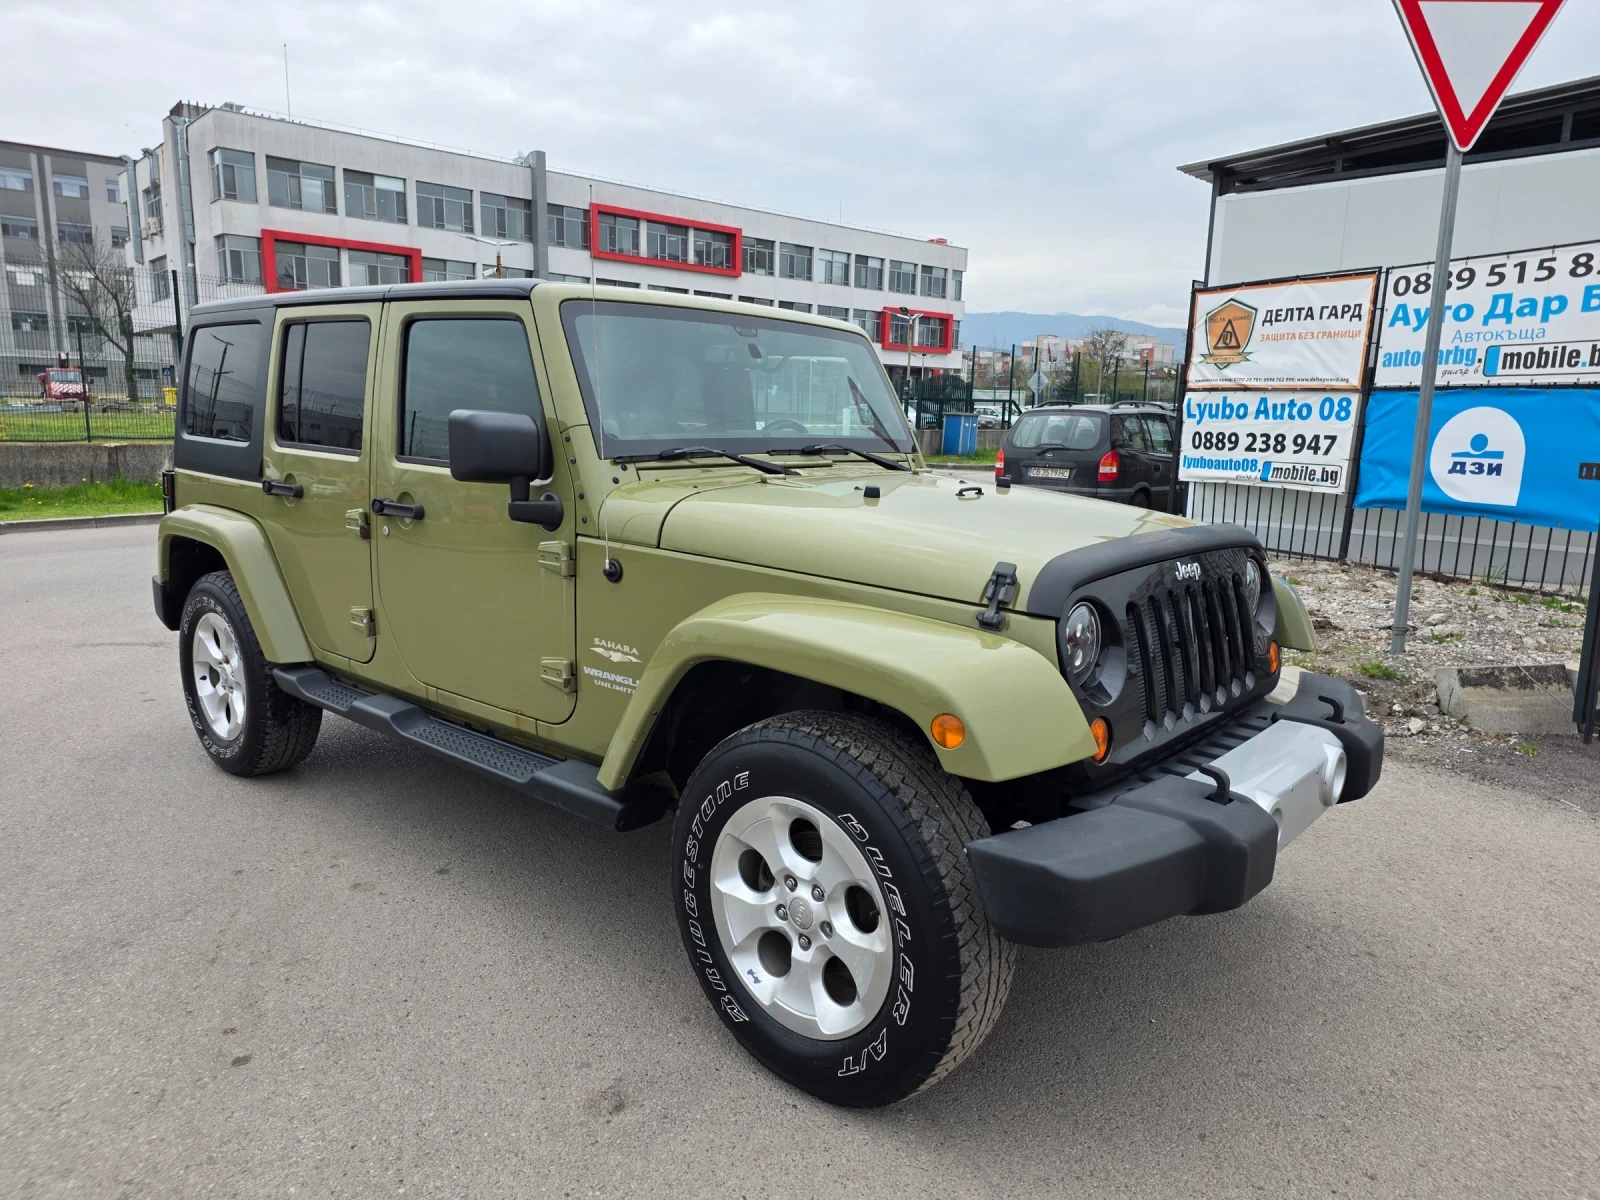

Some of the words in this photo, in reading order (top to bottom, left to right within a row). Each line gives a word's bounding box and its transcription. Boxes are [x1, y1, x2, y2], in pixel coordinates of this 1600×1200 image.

[1485, 256, 1557, 287] 515
[1568, 252, 1600, 278] 8
[1232, 314, 1251, 322] GUARD
[1262, 306, 1315, 327] ДЕЛТА
[1319, 303, 1363, 323] ГАРД
[1482, 292, 1569, 327] Дар
[1260, 332, 1297, 342] ЗАЩИТА
[1298, 331, 1315, 340] БЕЗ
[1316, 329, 1362, 340] ГРАНИЦИ
[1451, 326, 1546, 343] Автокъща
[1382, 345, 1482, 368] autoarbg.
[1186, 396, 1249, 425] Lyubo
[1254, 397, 1313, 421] Auto
[1319, 396, 1353, 422] 08
[1191, 431, 1240, 452] 0889
[1244, 432, 1287, 454] 238
[1292, 433, 1338, 456] 947
[1270, 465, 1339, 485] mobile.bg
[1447, 460, 1503, 477] ДЗИ
[1175, 561, 1201, 581] Jeep
[593, 637, 639, 656] SAHARA
[583, 665, 640, 687] WRANGL
[594, 679, 636, 695] UNLIMIT
[683, 770, 750, 1022] BRIDGESTONE
[837, 813, 914, 1026] DUELER
[837, 1027, 887, 1077] A/T
